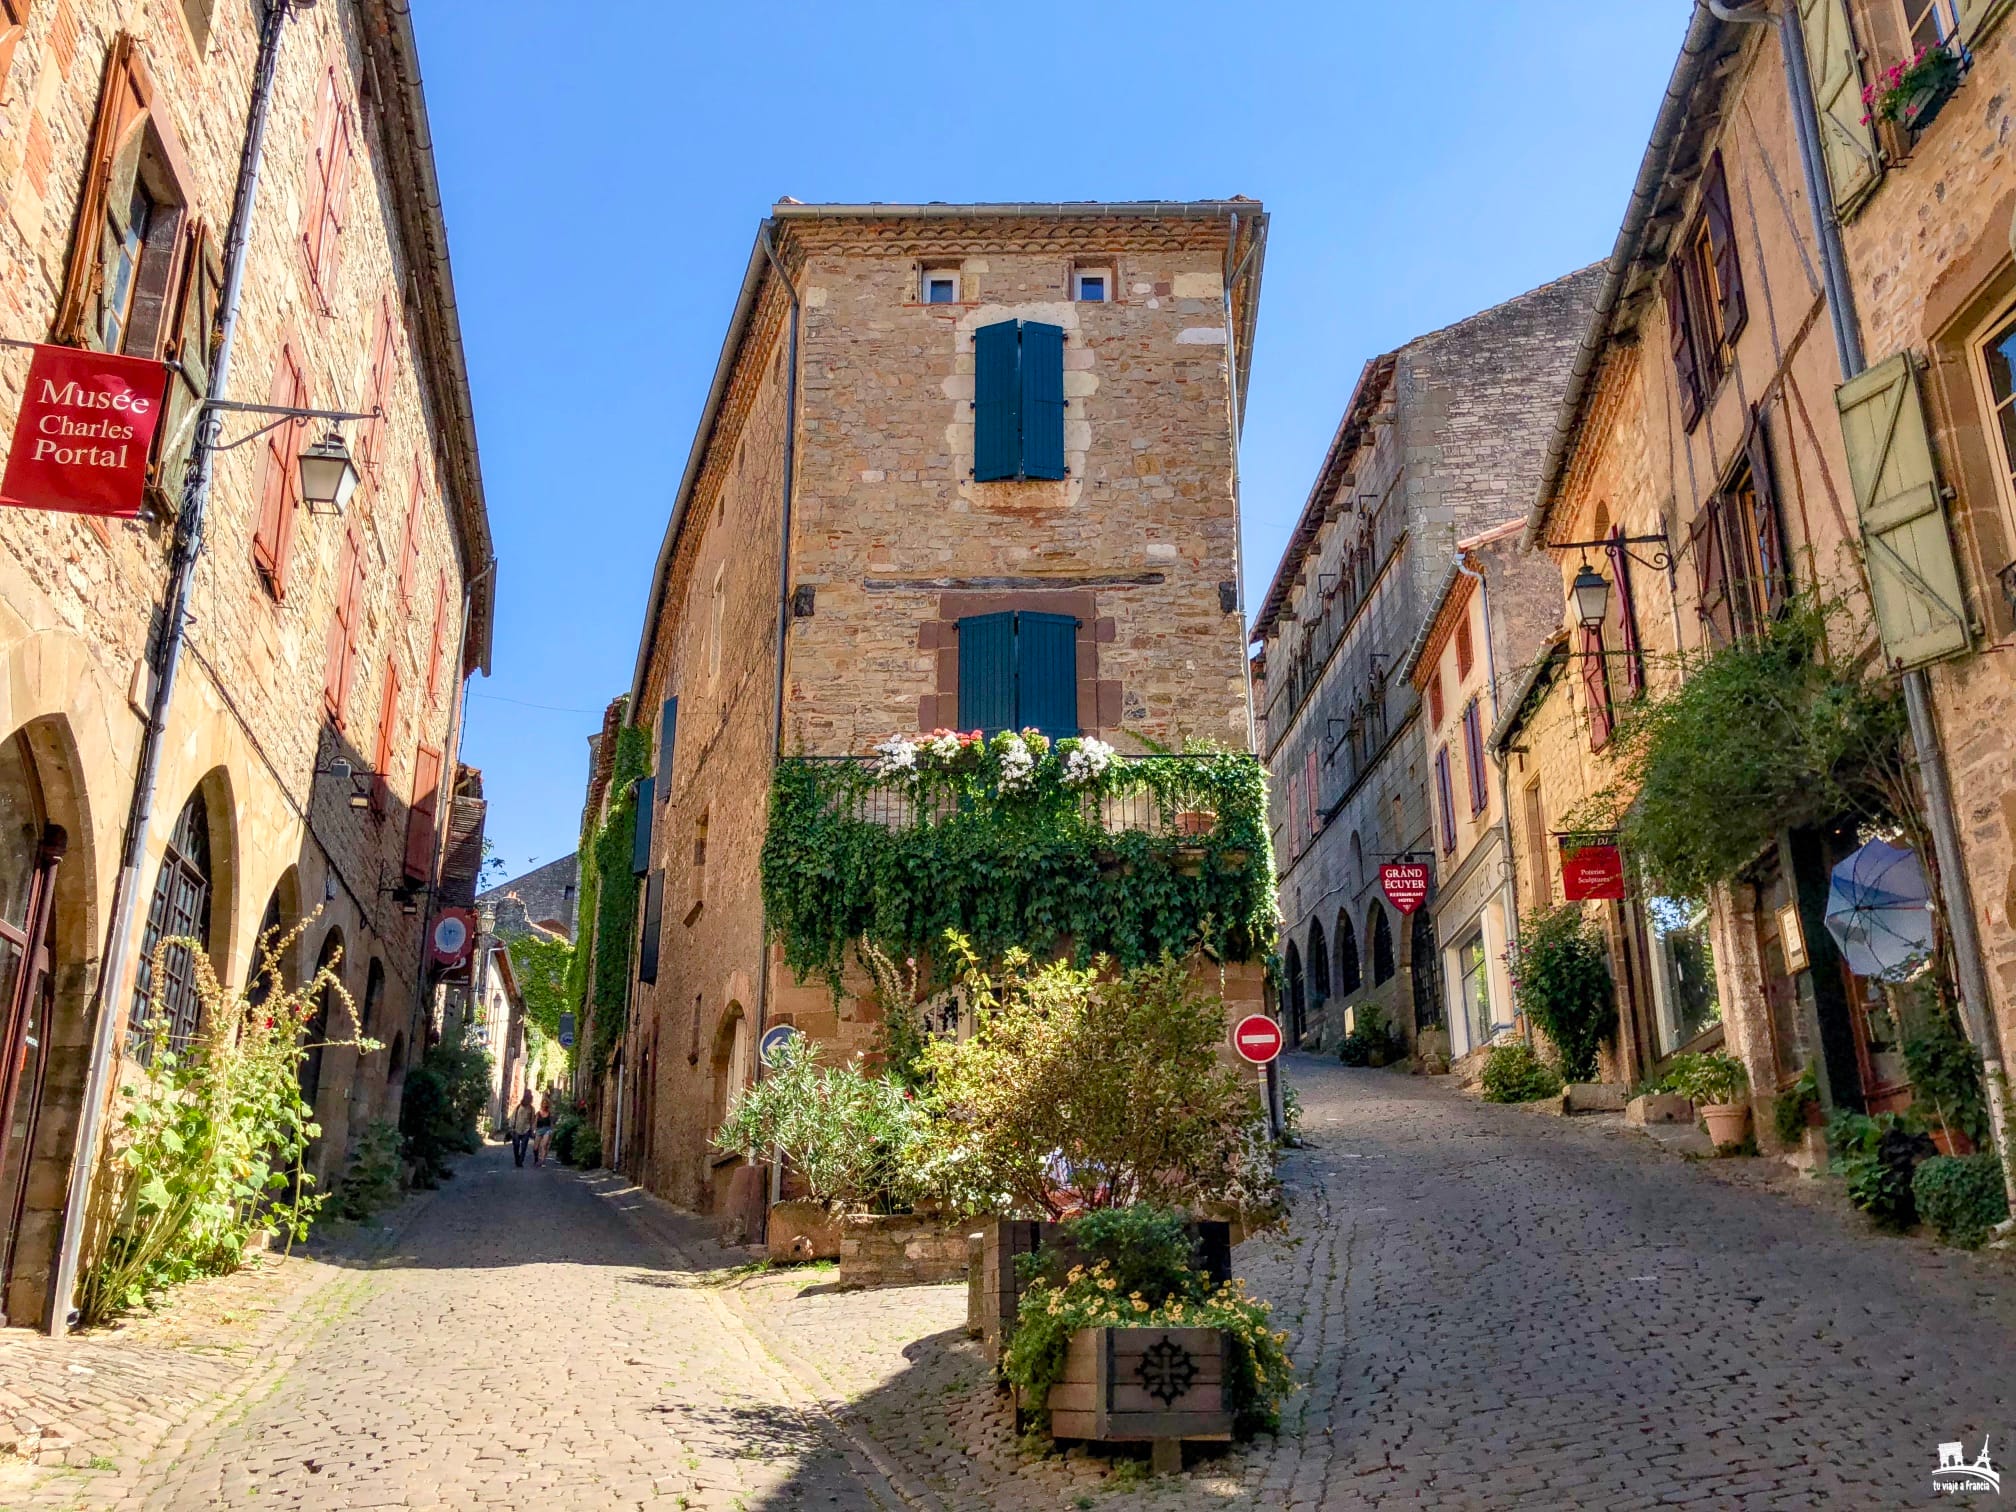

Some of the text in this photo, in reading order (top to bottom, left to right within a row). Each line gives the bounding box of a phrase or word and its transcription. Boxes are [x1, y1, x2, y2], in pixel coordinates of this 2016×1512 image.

[37, 379, 149, 414] Musée
[39, 415, 134, 439] Charles
[31, 439, 128, 468] Portal
[1385, 868, 1423, 878] GRAND
